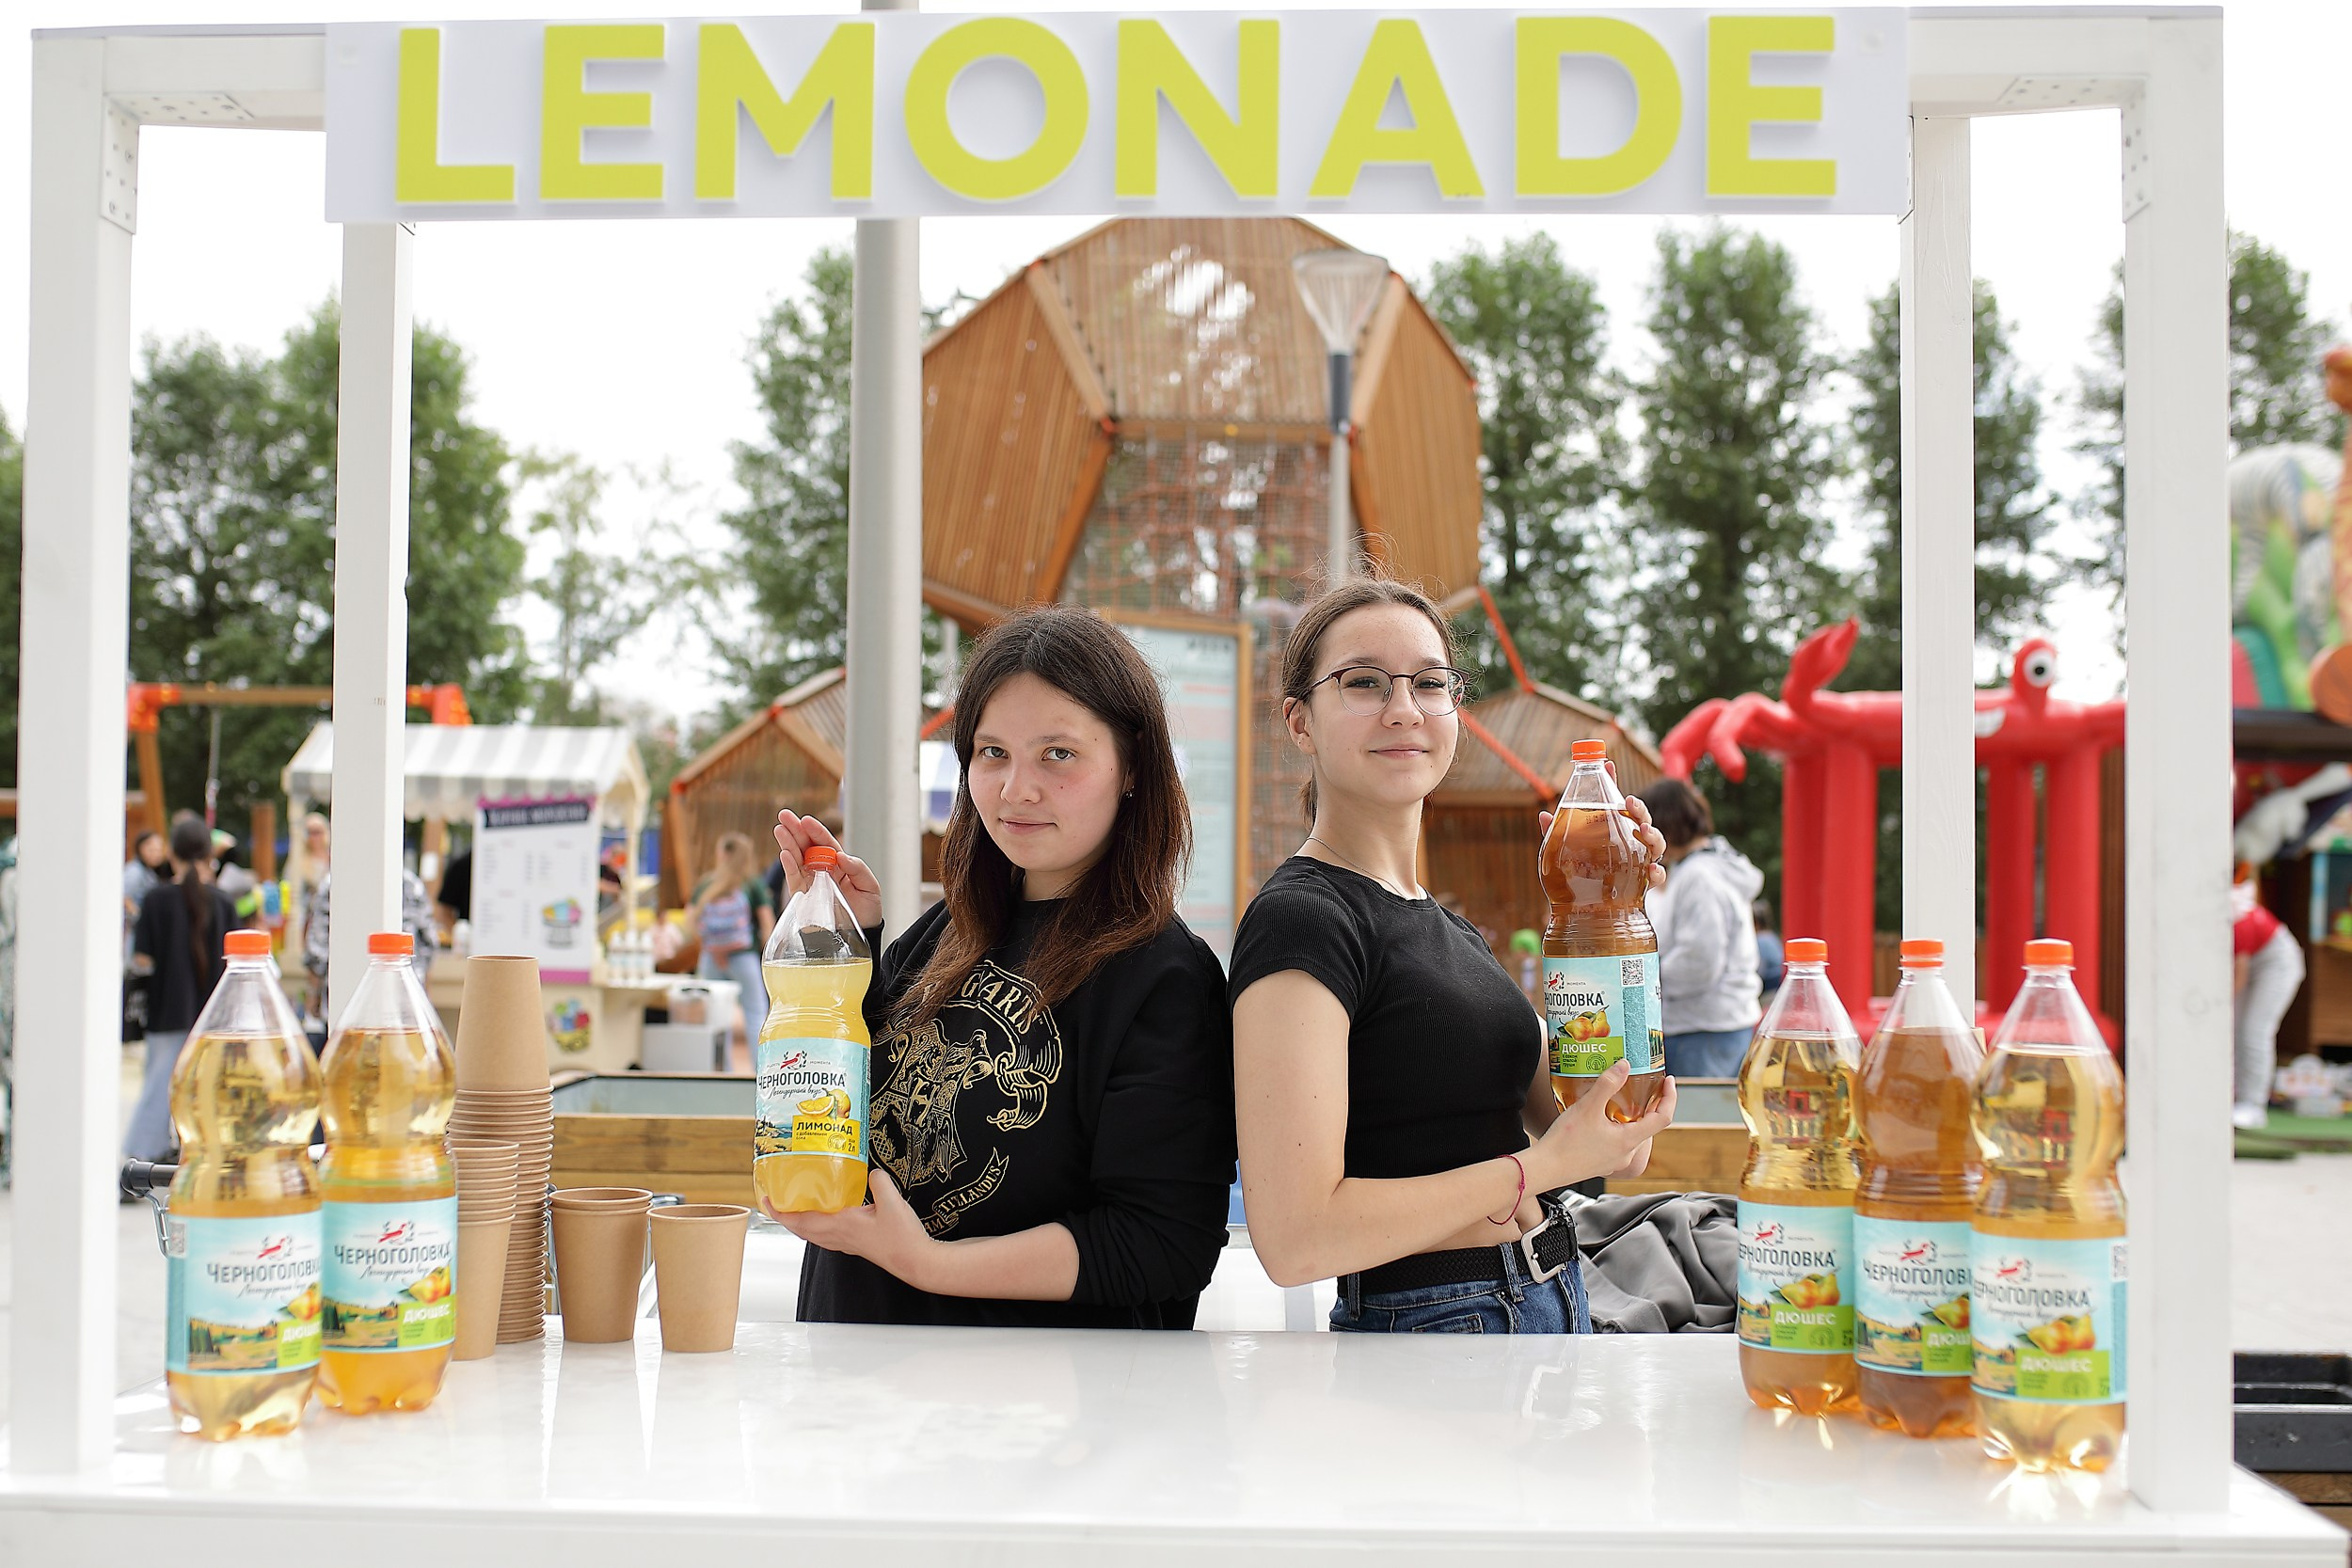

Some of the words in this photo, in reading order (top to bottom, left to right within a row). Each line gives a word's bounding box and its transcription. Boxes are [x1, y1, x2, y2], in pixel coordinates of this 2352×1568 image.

[394, 15, 1837, 203] LEMONADE
[1545, 992, 1604, 1006] НОГОЛОВКА
[1562, 1043, 1608, 1054] ДЮШЕС
[758, 1071, 846, 1090] ЧЕРНОГОЛОВКА
[796, 1121, 853, 1136] ЛИМОНАД
[334, 1241, 452, 1265] ЧЕРНОГОЛОВКА
[1740, 1243, 1836, 1268] ЕРНОГОЛОВКА
[1863, 1259, 1972, 1286] ЧЕРНОГОЛОВ
[1973, 1279, 2091, 1307] ЕРНОГОЛОВКА
[403, 1303, 452, 1325] ДЮШЕС
[1774, 1310, 1837, 1325] ДЮШЕС
[1927, 1332, 1971, 1347] ДЮШ
